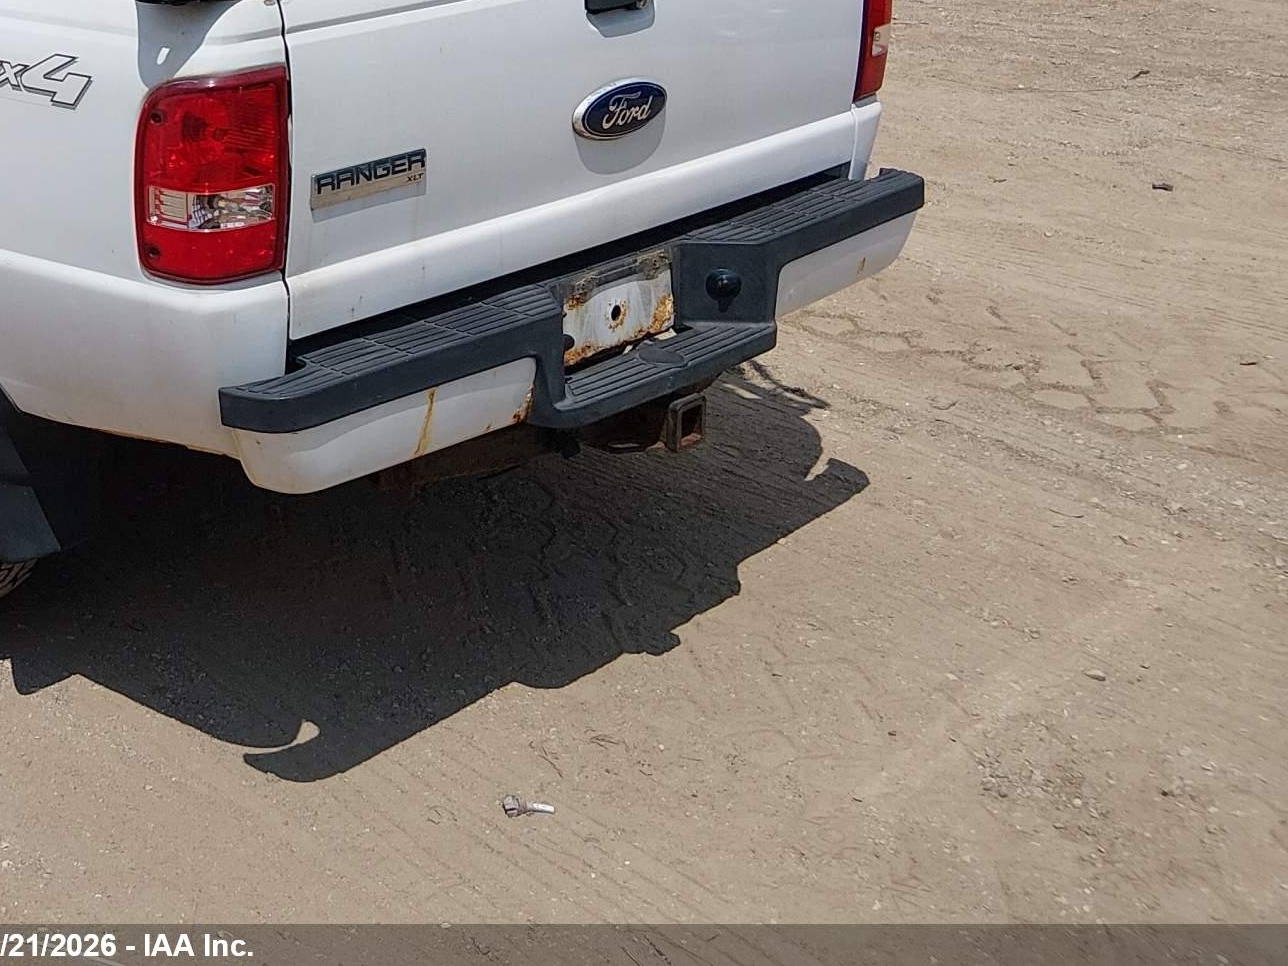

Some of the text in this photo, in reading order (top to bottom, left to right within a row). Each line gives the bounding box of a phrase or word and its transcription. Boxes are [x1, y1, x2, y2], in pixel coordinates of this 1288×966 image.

[601, 90, 654, 130] Ford
[316, 152, 426, 195] RANGER
[406, 172, 425, 183] XLT
